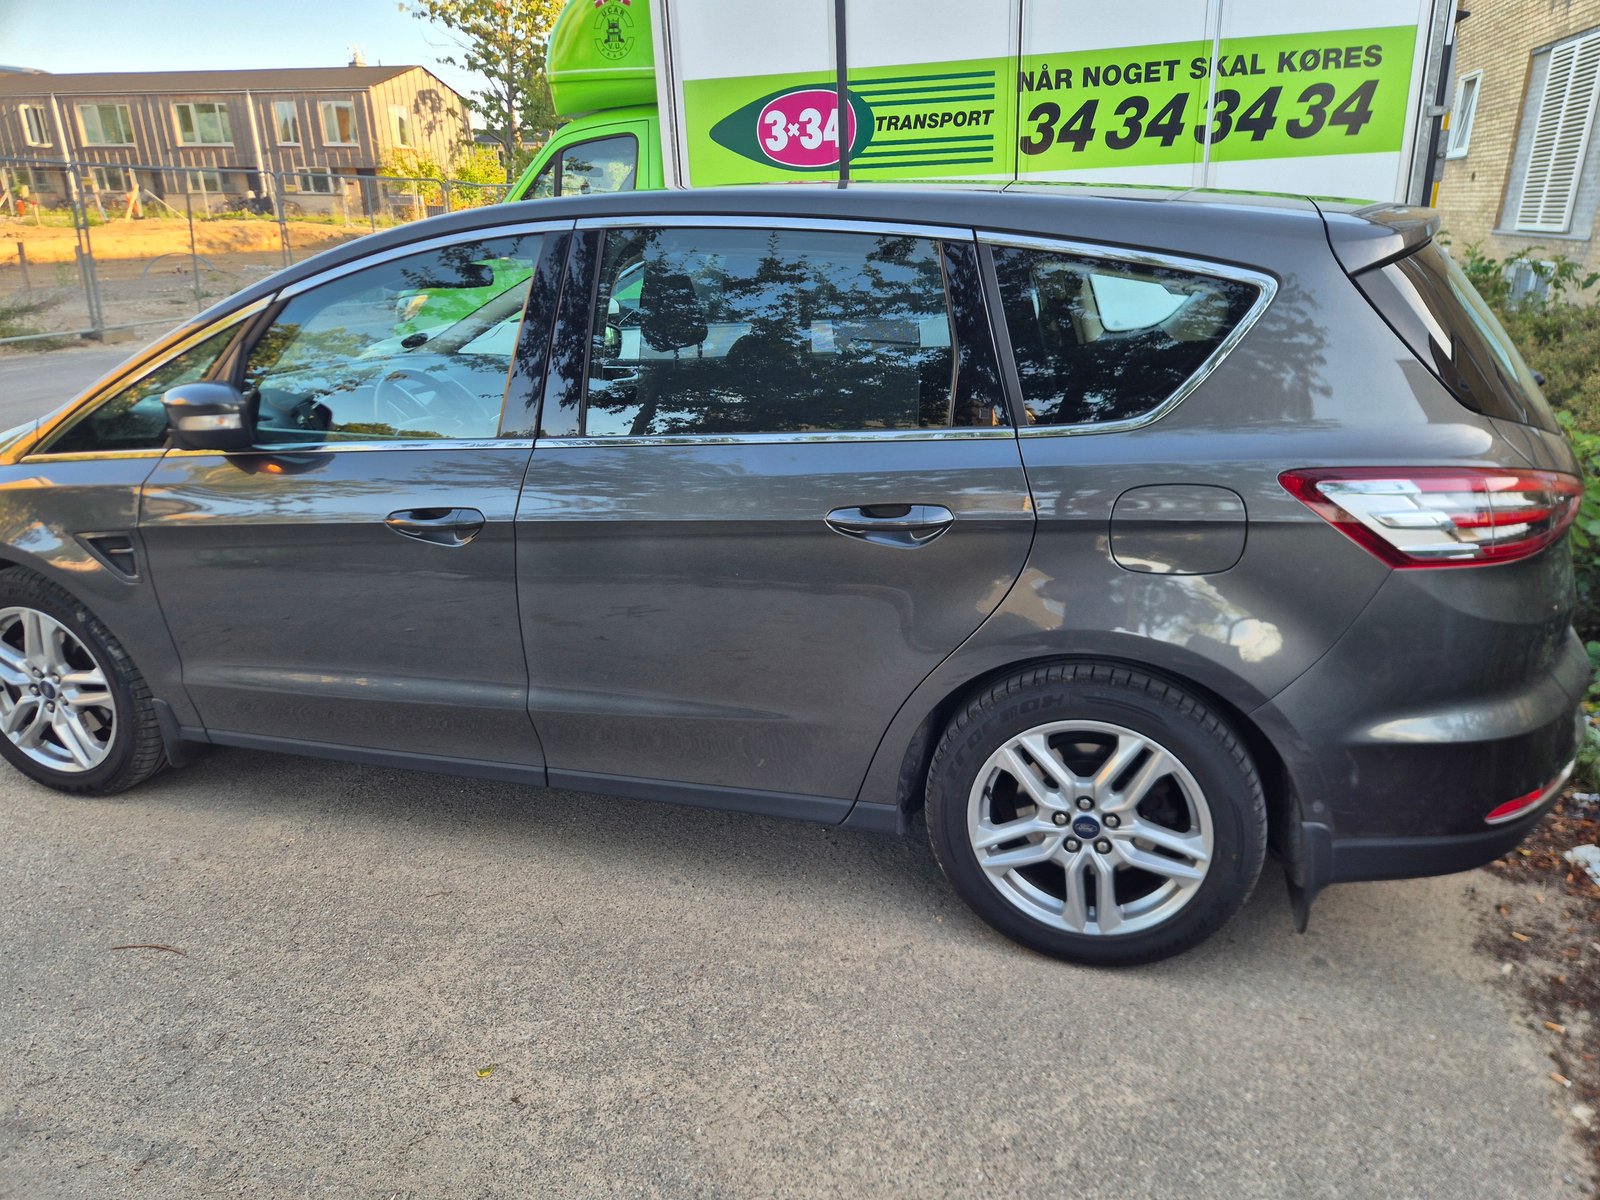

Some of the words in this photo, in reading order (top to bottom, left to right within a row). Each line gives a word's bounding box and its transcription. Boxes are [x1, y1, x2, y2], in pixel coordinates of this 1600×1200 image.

[1017, 64, 1073, 93] NÅR
[1082, 59, 1181, 88] NOGET
[1189, 53, 1266, 80] SKAL
[1276, 44, 1383, 73] KØRES
[875, 109, 995, 132] TRANSPORT
[1019, 99, 1100, 156] 34
[1105, 92, 1190, 150] 34
[1193, 85, 1283, 145] 34
[1286, 79, 1380, 139] 34
